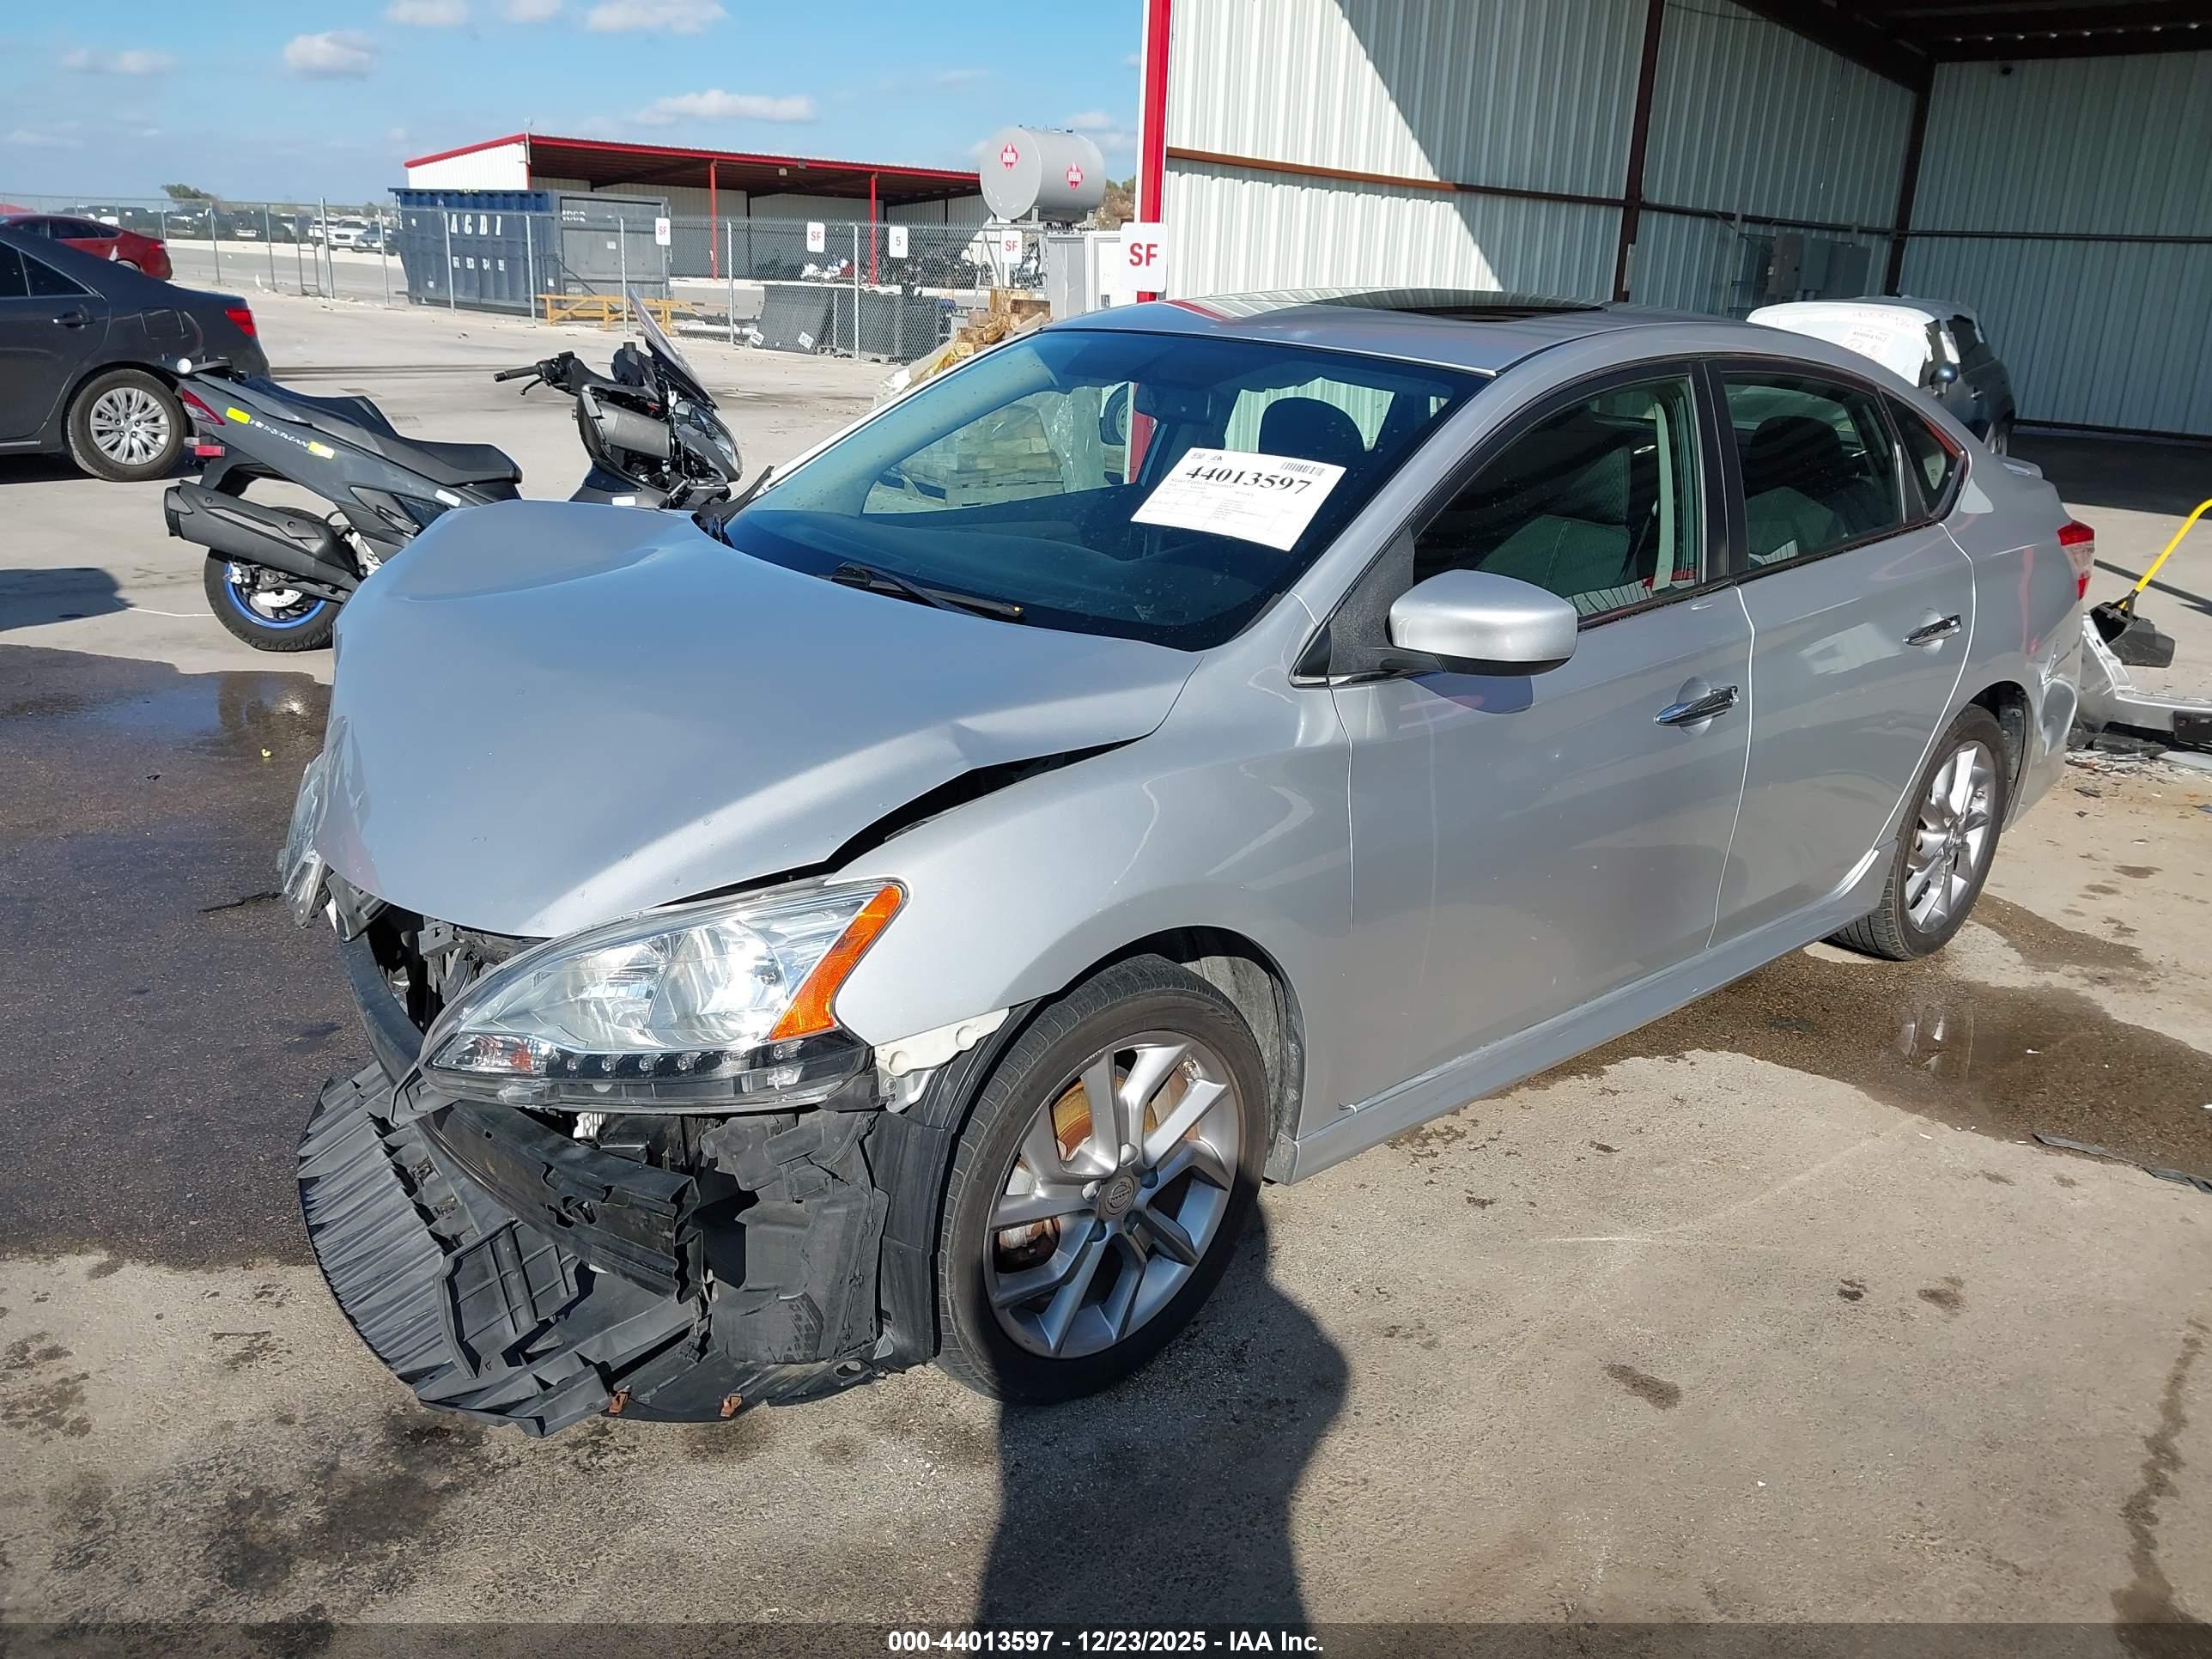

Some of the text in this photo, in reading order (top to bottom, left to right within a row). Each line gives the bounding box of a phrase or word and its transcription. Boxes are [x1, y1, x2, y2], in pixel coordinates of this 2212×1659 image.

[659, 226, 667, 235] SF
[811, 231, 822, 242] SF
[896, 236, 902, 246] 5
[1006, 240, 1018, 252] SF
[1129, 242, 1158, 267] SF
[1186, 465, 1313, 495] 44013597
